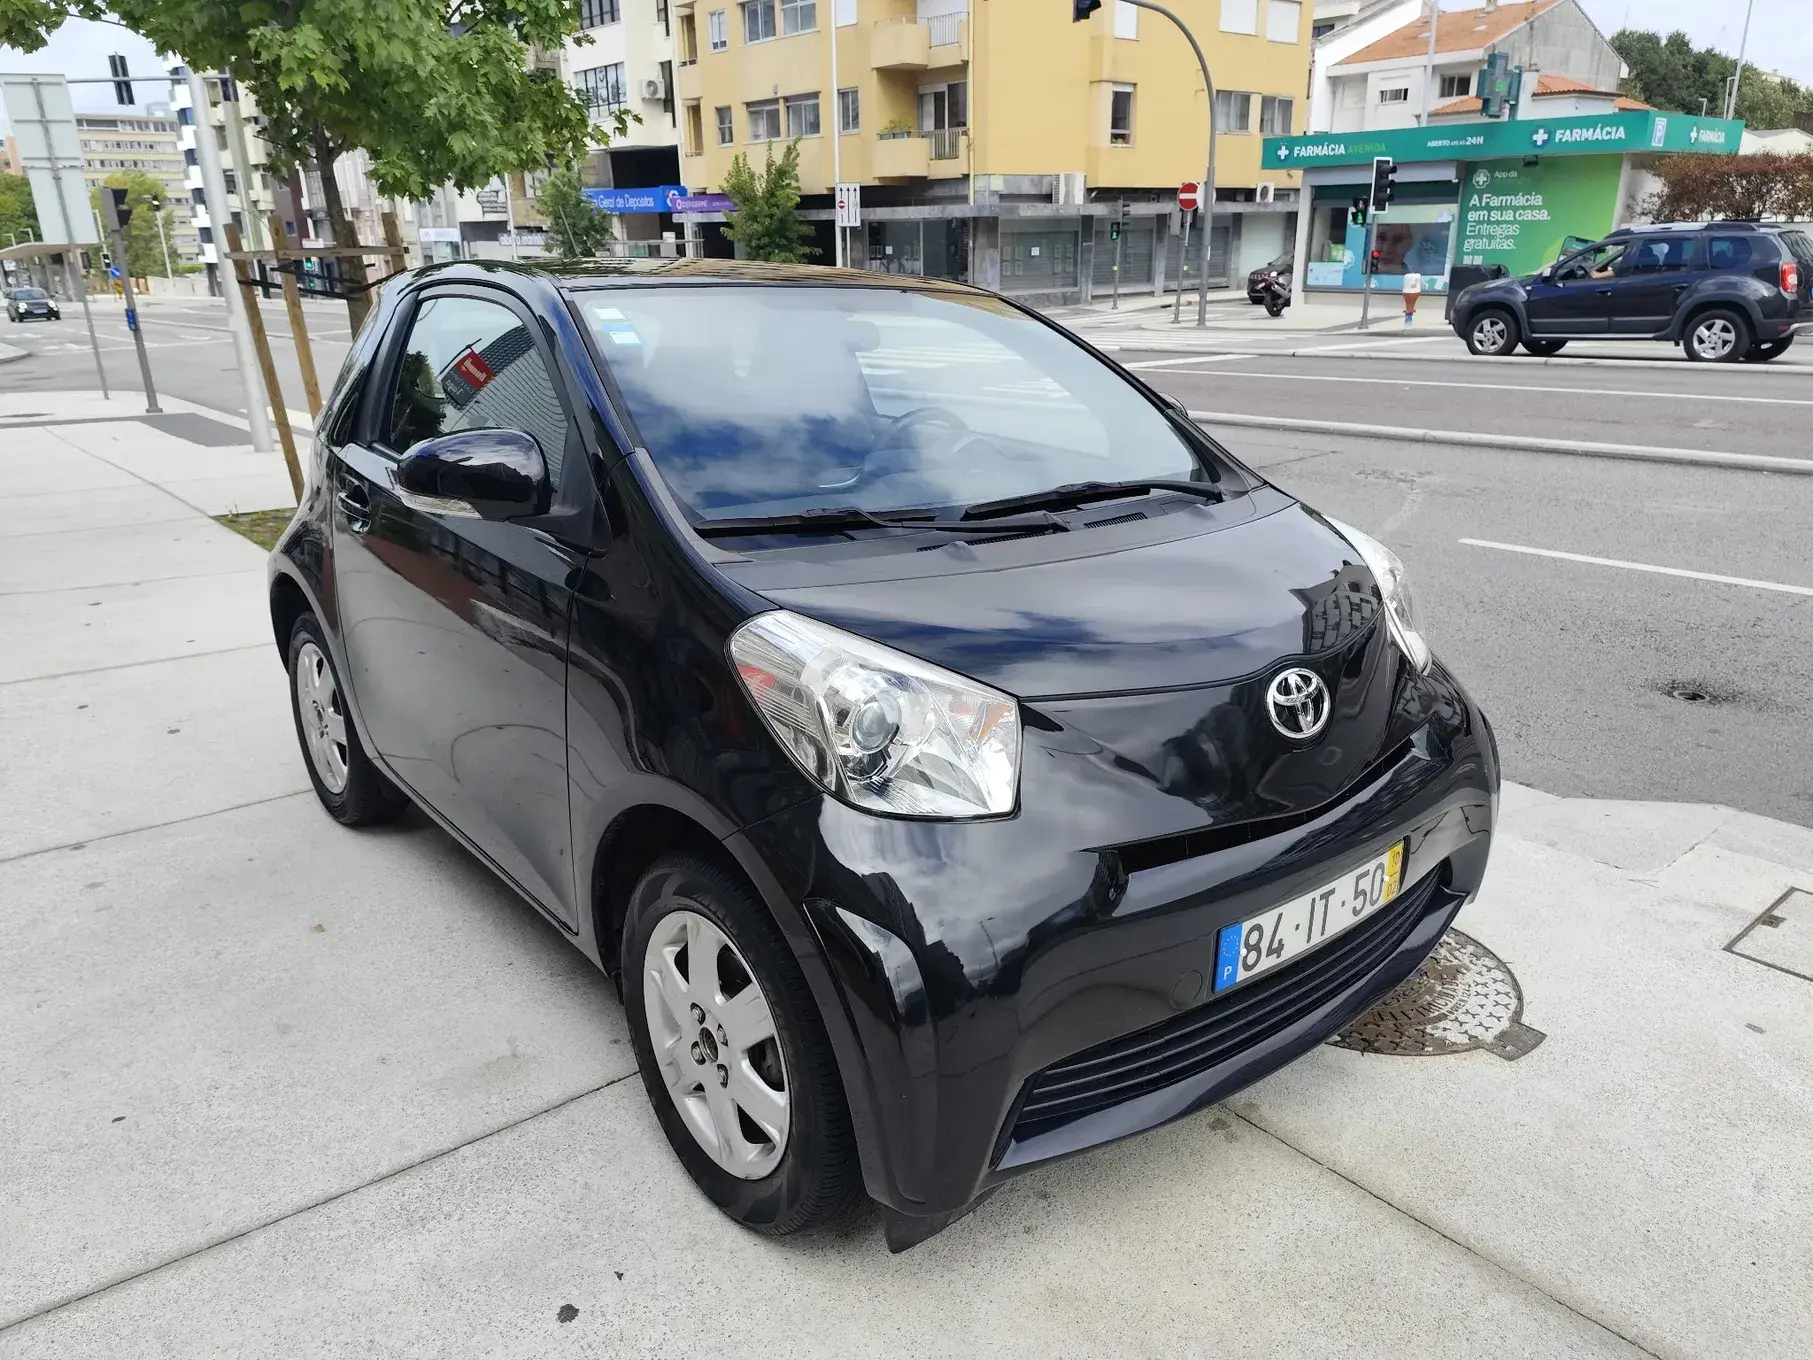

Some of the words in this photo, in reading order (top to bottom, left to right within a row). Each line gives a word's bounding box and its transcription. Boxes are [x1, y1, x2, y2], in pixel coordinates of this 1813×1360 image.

[1555, 124, 1625, 143] FARMÁCIA
[1699, 128, 1725, 144] FARMÁCIA
[1293, 142, 1345, 157] FARMÁCIA
[1347, 143, 1386, 154] AVENIDA
[1427, 139, 1450, 148] ABERTO
[1466, 136, 1484, 146] 24H
[1494, 170, 1508, 179] App
[599, 194, 615, 208] Geral
[616, 195, 624, 207] de
[1469, 194, 1480, 207] A
[1482, 192, 1543, 206] Farmácia
[1467, 210, 1488, 221] em
[1490, 210, 1514, 221] sua
[1515, 209, 1551, 220] casa.
[1466, 222, 1520, 238] Entregas
[1463, 238, 1516, 252] gratuitas.
[1386, 882, 1397, 898] 02
[1223, 965, 1232, 981] P
